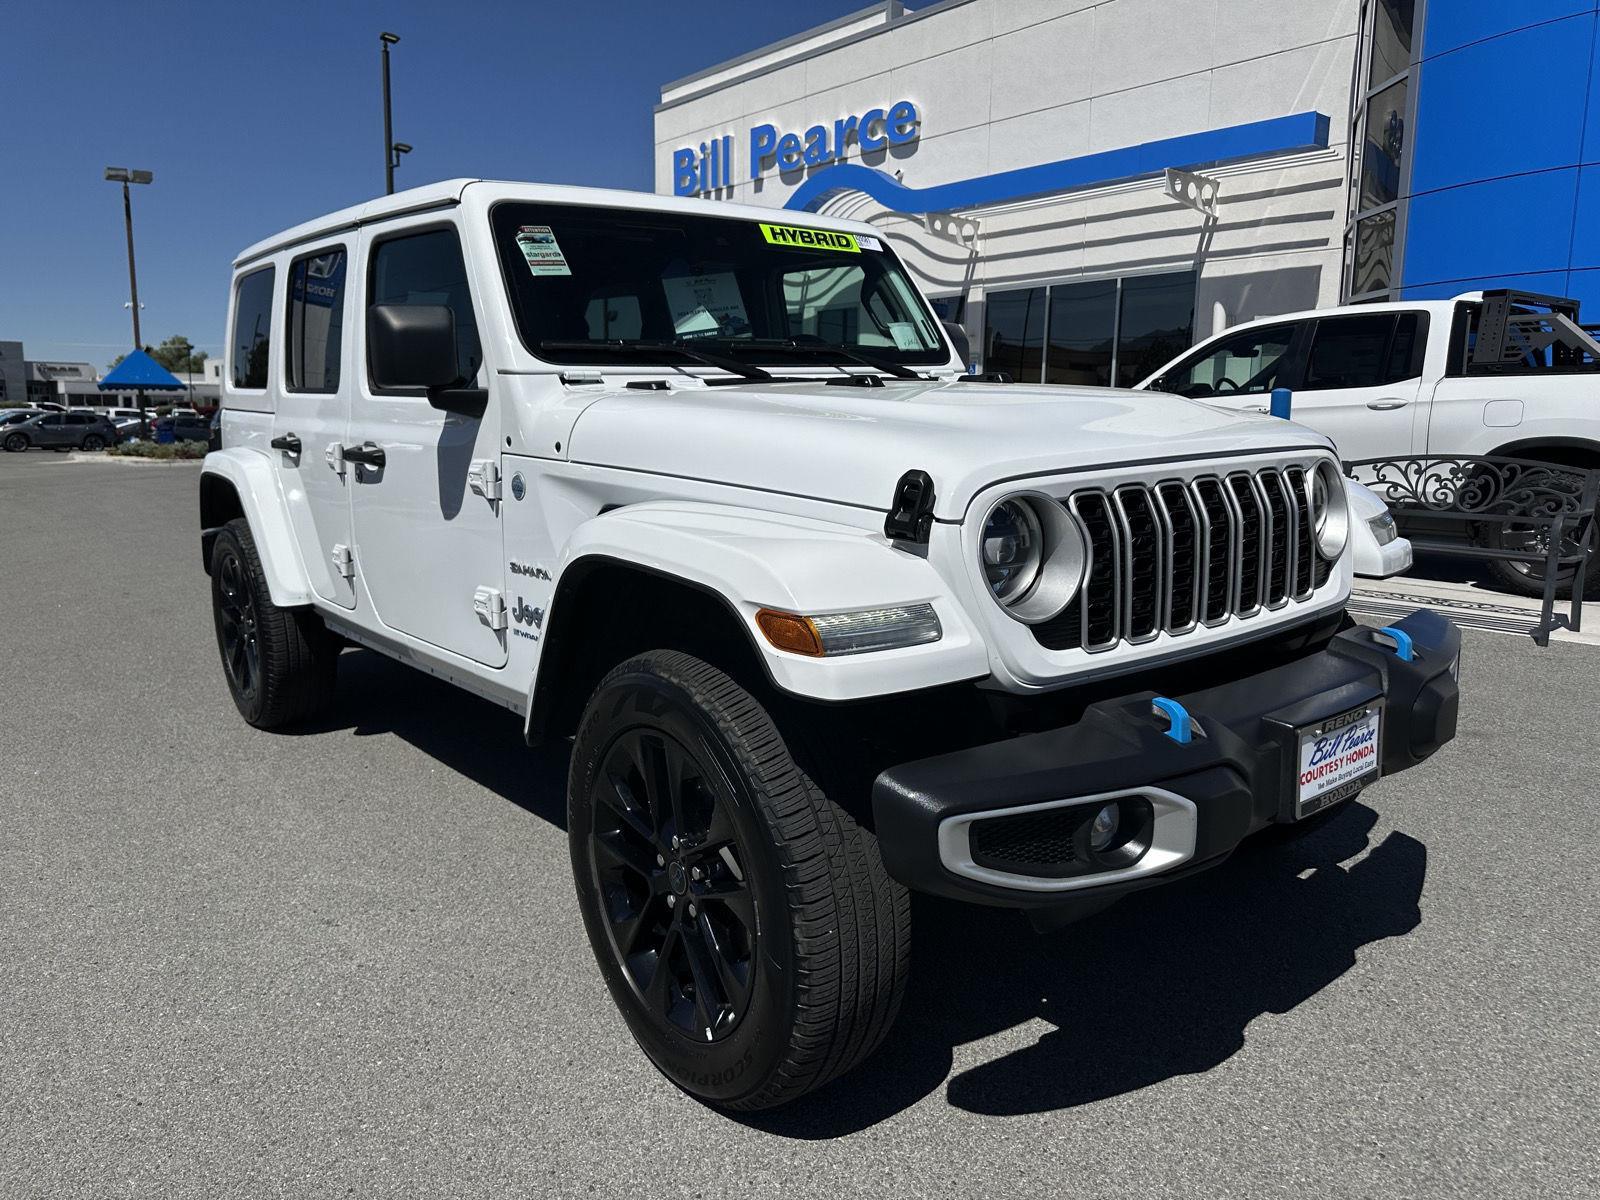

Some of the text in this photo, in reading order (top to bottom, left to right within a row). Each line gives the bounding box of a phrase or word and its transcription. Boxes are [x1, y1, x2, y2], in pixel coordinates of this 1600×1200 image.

[673, 101, 917, 197] Bill Pearce
[769, 226, 852, 248] HYBRID
[1324, 708, 1366, 733] RENO
[1308, 725, 1376, 767] Bill Pearce
[1300, 744, 1375, 785] COURTESY HONDA
[1326, 776, 1338, 786] Make
[1338, 770, 1353, 780] Buying
[1353, 764, 1364, 774] Local
[1364, 760, 1374, 769] Easy
[1319, 779, 1363, 806] HONDA
